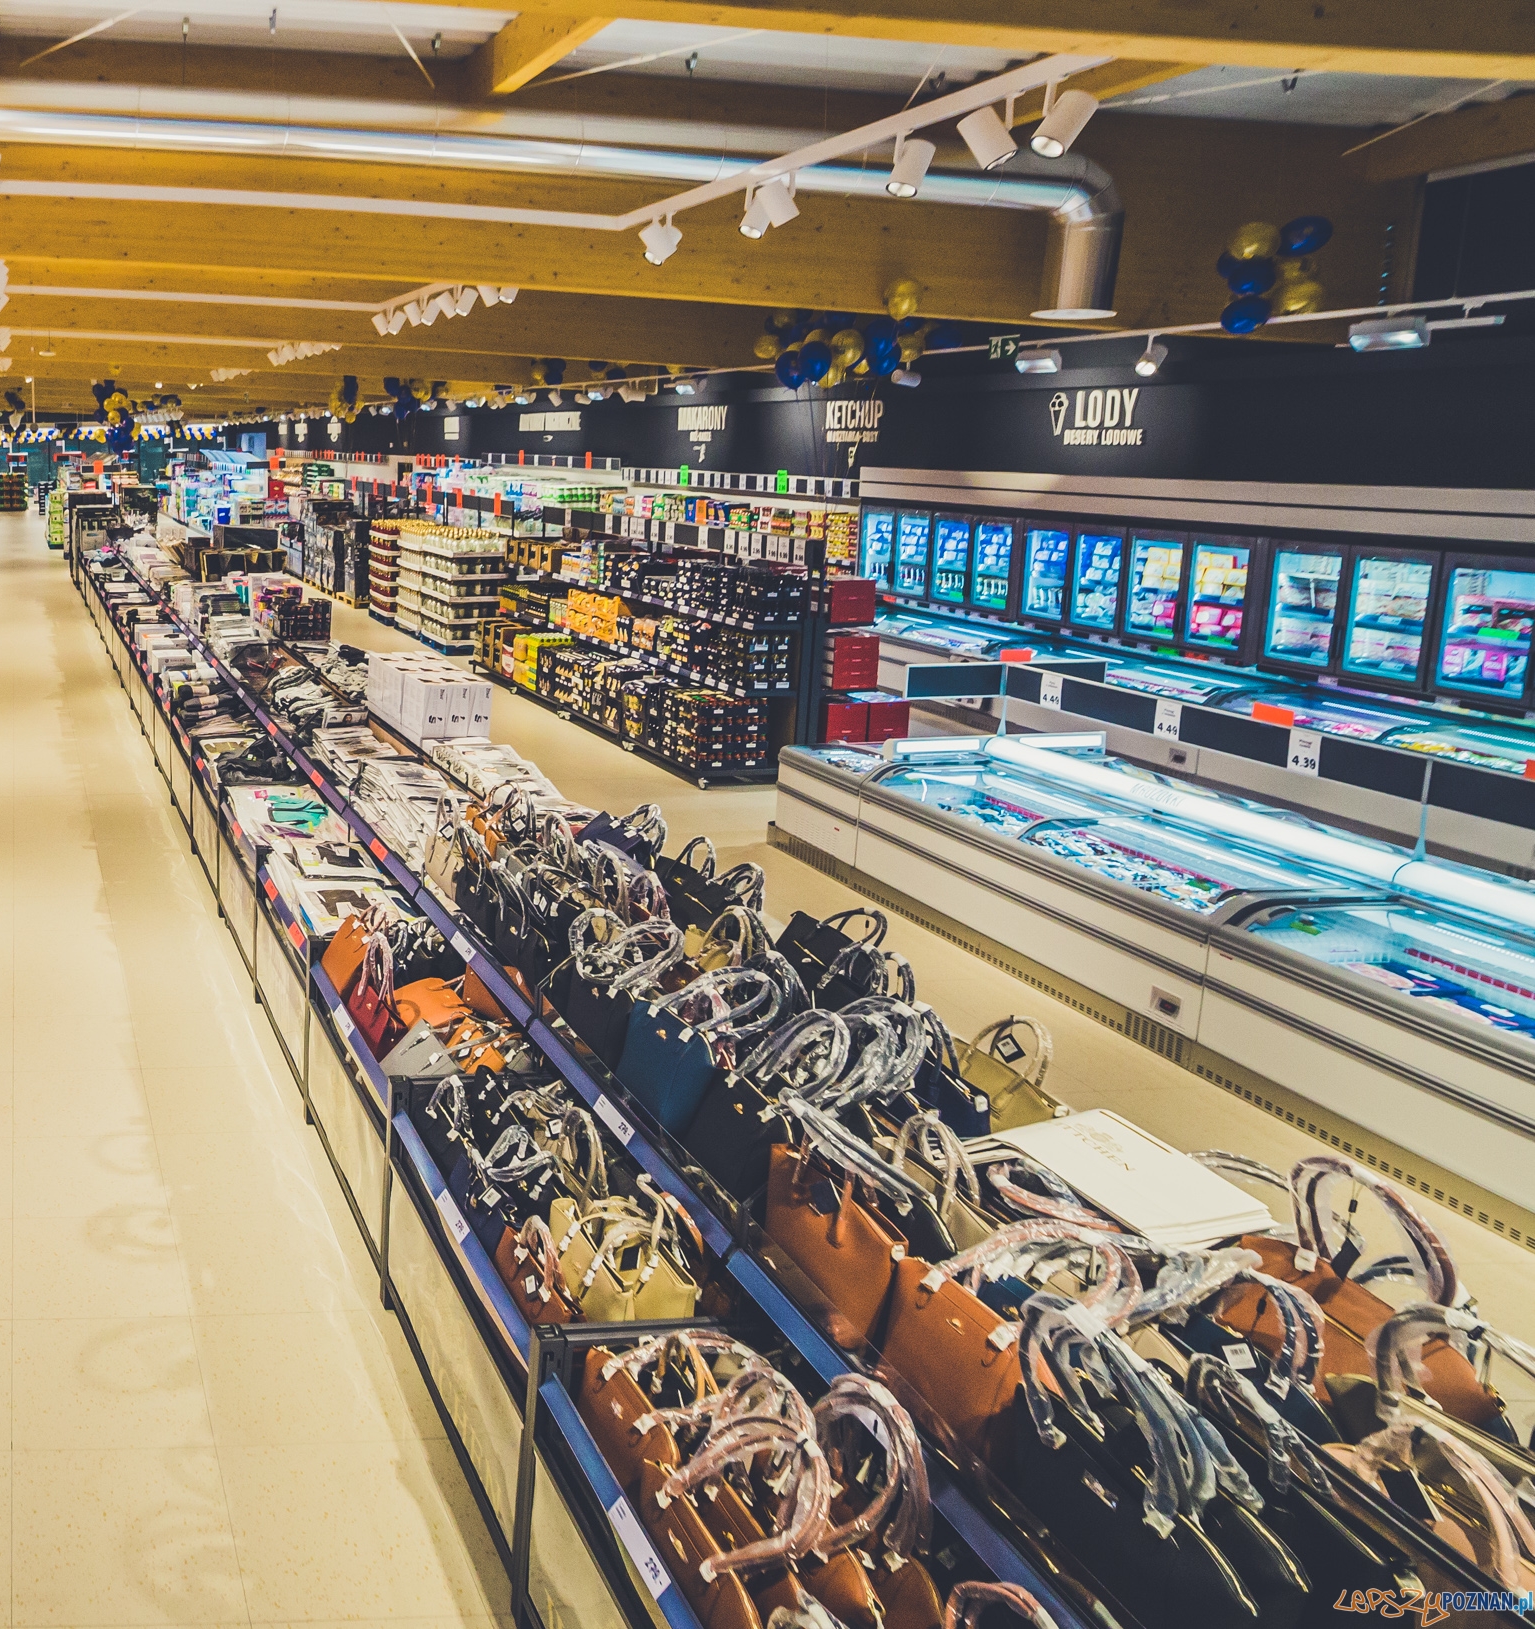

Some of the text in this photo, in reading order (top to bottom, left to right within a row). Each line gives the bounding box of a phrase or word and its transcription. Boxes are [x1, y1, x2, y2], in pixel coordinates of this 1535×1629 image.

[826, 400, 883, 429] KETCHUP
[1074, 388, 1140, 428] LODY
[678, 406, 728, 430] MAKARONY
[1063, 428, 1143, 446] DESERY LODOWE
[1042, 692, 1060, 705] 4.49
[1157, 722, 1178, 736] 4.49
[1292, 755, 1316, 770] 4.39
